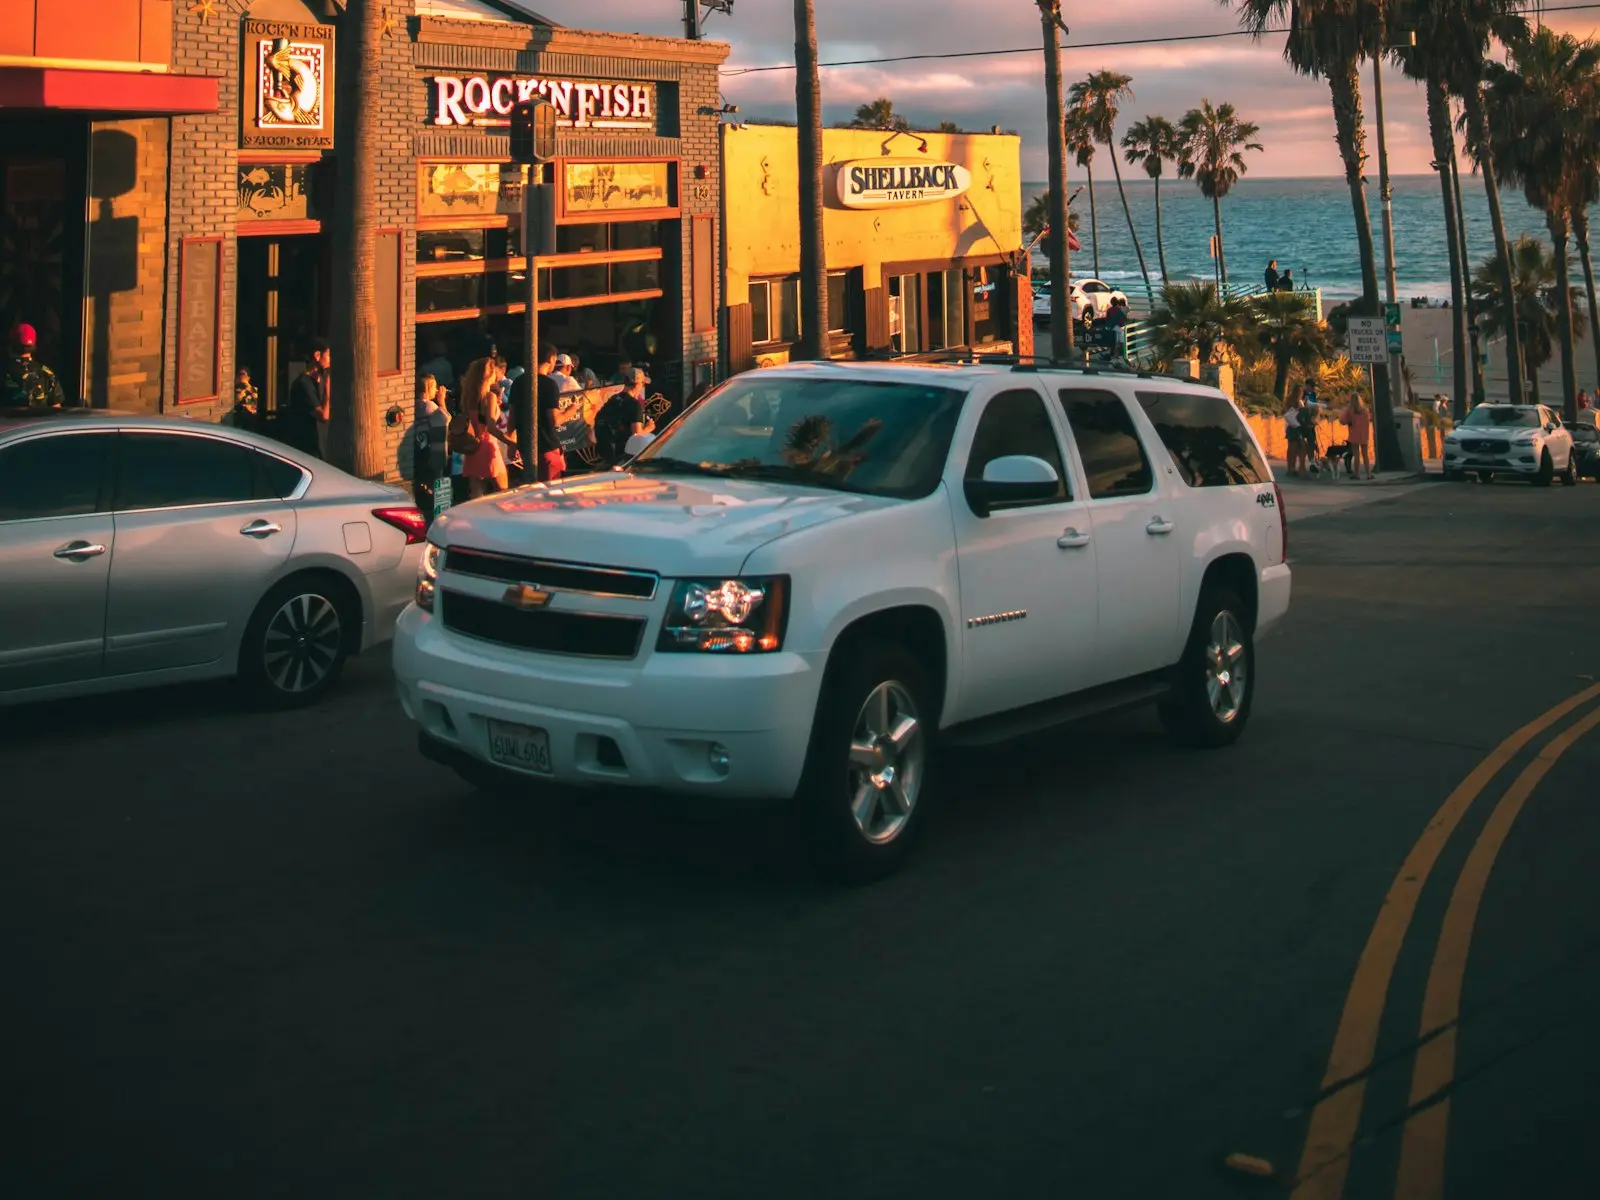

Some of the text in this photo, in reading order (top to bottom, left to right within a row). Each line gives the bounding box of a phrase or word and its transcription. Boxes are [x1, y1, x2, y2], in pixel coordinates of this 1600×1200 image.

[246, 21, 332, 40] ROCK'N FISH
[851, 165, 958, 195] SHELLBACK
[695, 186, 710, 200] 120
[887, 190, 924, 201] TAVERN
[187, 259, 208, 382] STEAKS
[1361, 320, 1372, 328] NO
